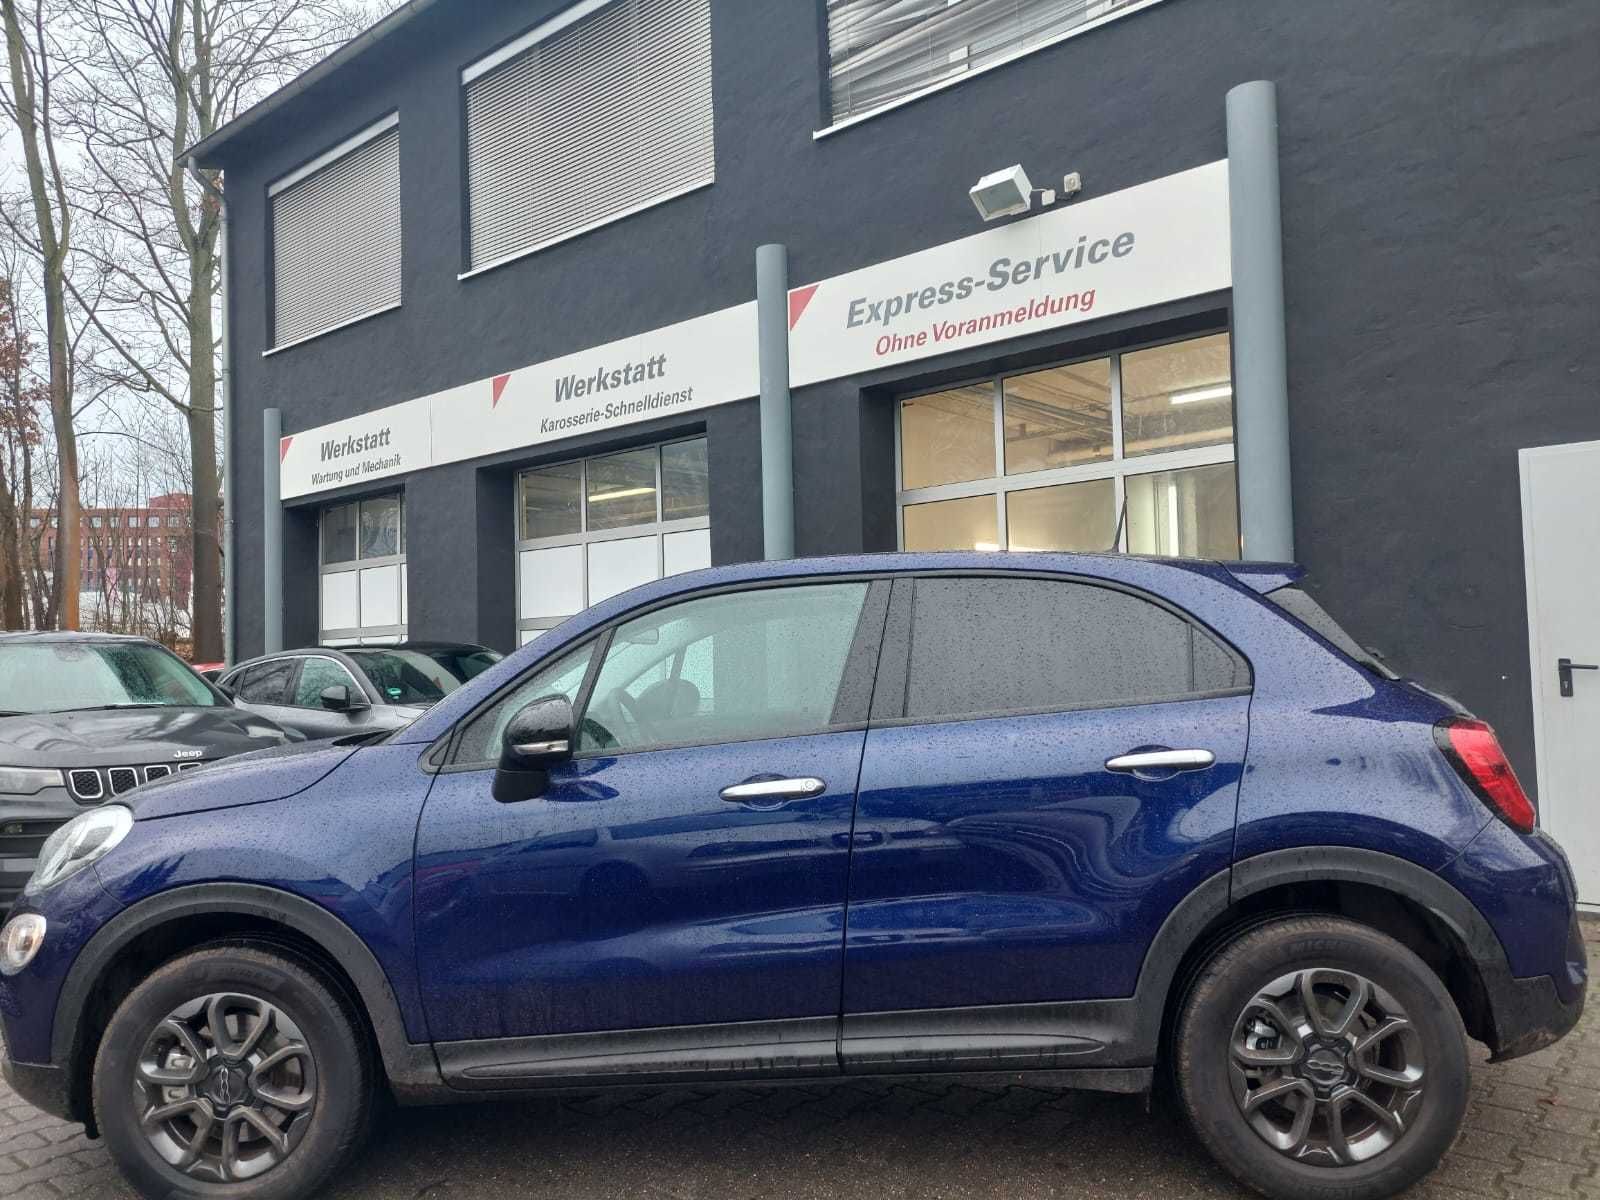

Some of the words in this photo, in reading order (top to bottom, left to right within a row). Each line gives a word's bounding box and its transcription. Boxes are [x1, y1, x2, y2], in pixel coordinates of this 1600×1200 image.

[846, 231, 1135, 329] Express-Service
[875, 329, 927, 356] Ohne
[932, 289, 1096, 342] Voranmeldung
[555, 353, 667, 403] Werkstatt
[540, 386, 694, 434] Karosserie-Schnelldienst
[320, 427, 391, 462] Werkstatt
[311, 469, 343, 486] Wartung
[344, 463, 361, 478] und
[361, 453, 402, 475] Mechanik
[173, 750, 203, 758] Jeep
